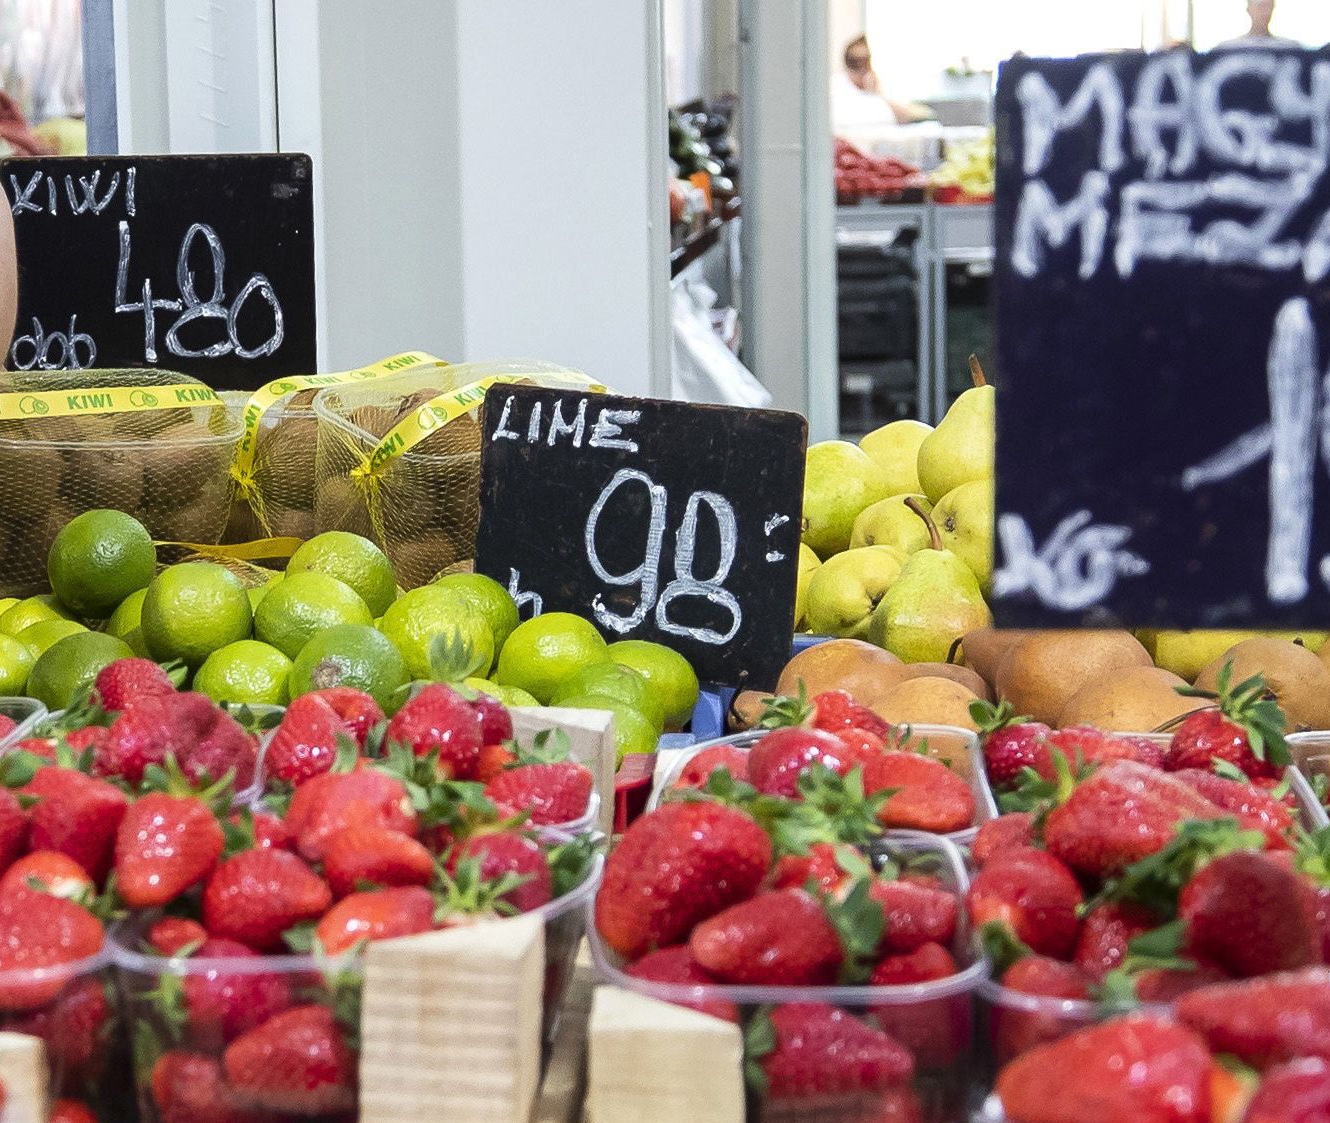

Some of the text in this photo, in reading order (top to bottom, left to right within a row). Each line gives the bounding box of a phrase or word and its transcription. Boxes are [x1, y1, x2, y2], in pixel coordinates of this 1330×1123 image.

[10, 166, 136, 217] KIWI
[115, 220, 284, 363] 480
[383, 355, 421, 371] KIWI
[66, 394, 113, 410] KIWI
[491, 395, 642, 452] LIME
[584, 467, 742, 644] 98
